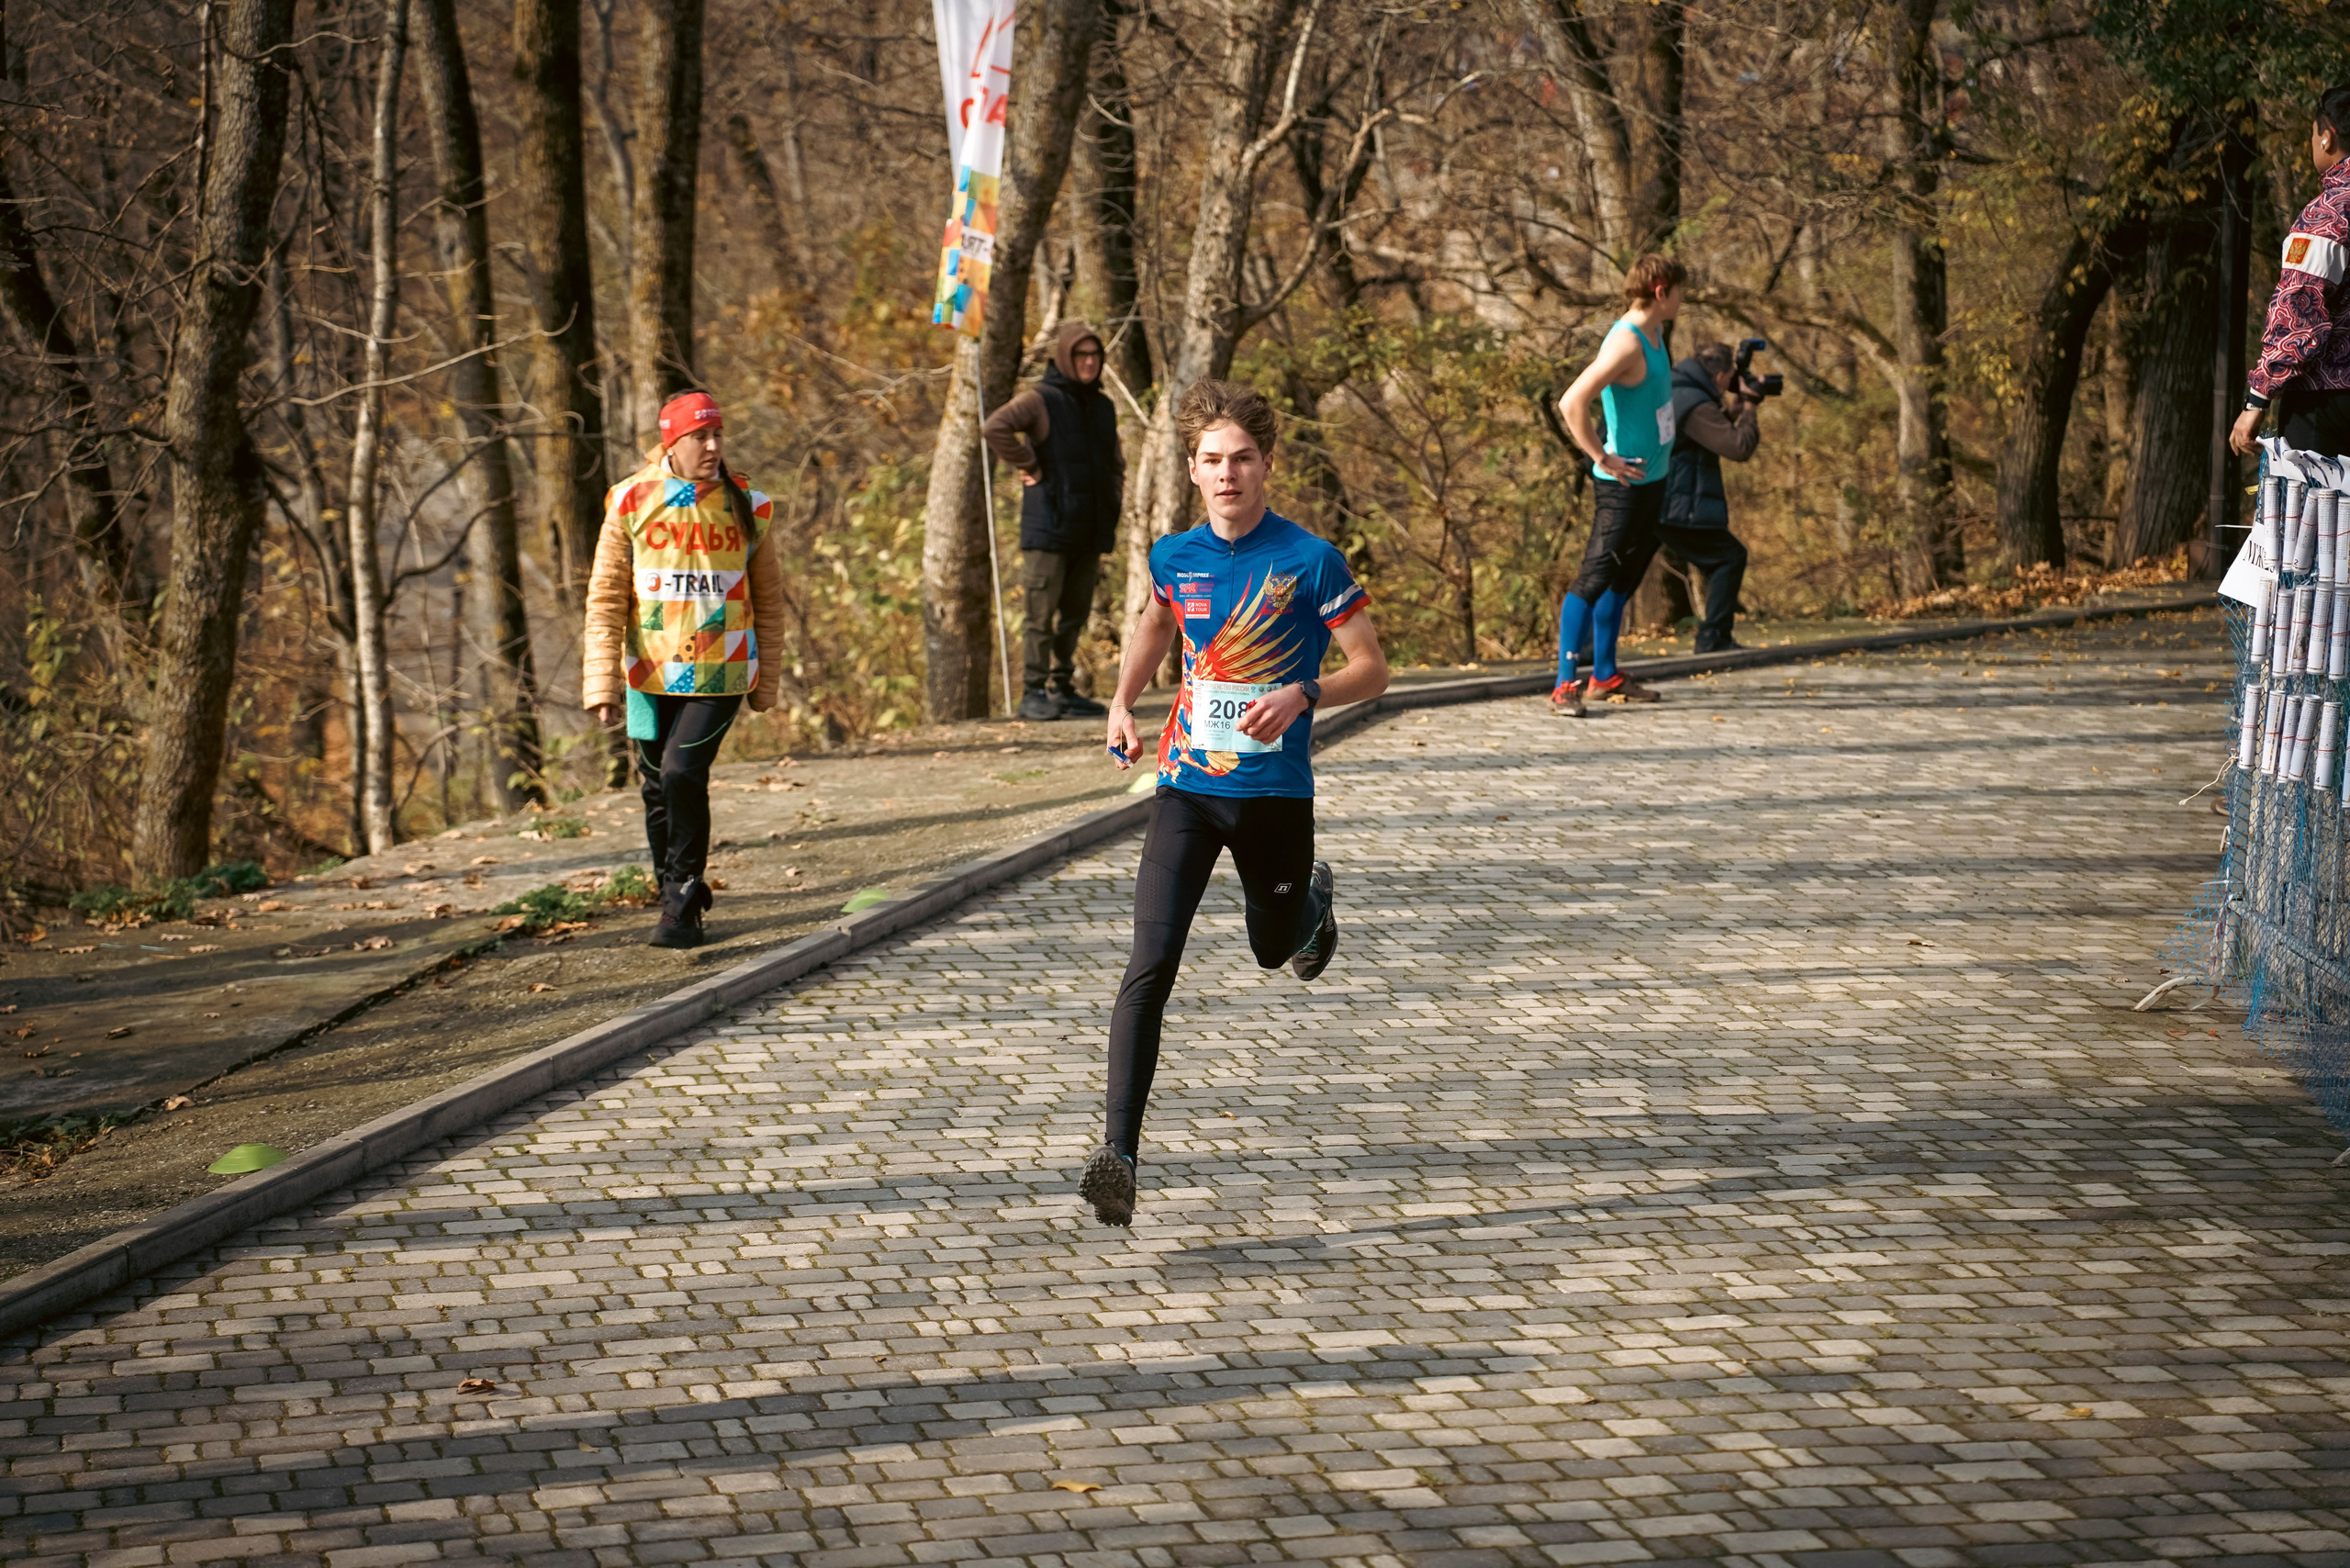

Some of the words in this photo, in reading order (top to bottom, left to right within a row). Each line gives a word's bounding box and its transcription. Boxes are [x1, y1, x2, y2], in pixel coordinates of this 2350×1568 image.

[645, 521, 741, 555] СУДЬЯ
[2294, 558, 2299, 566] 2
[1208, 699, 1248, 720] 208
[1204, 720, 1231, 730] МЖ16
